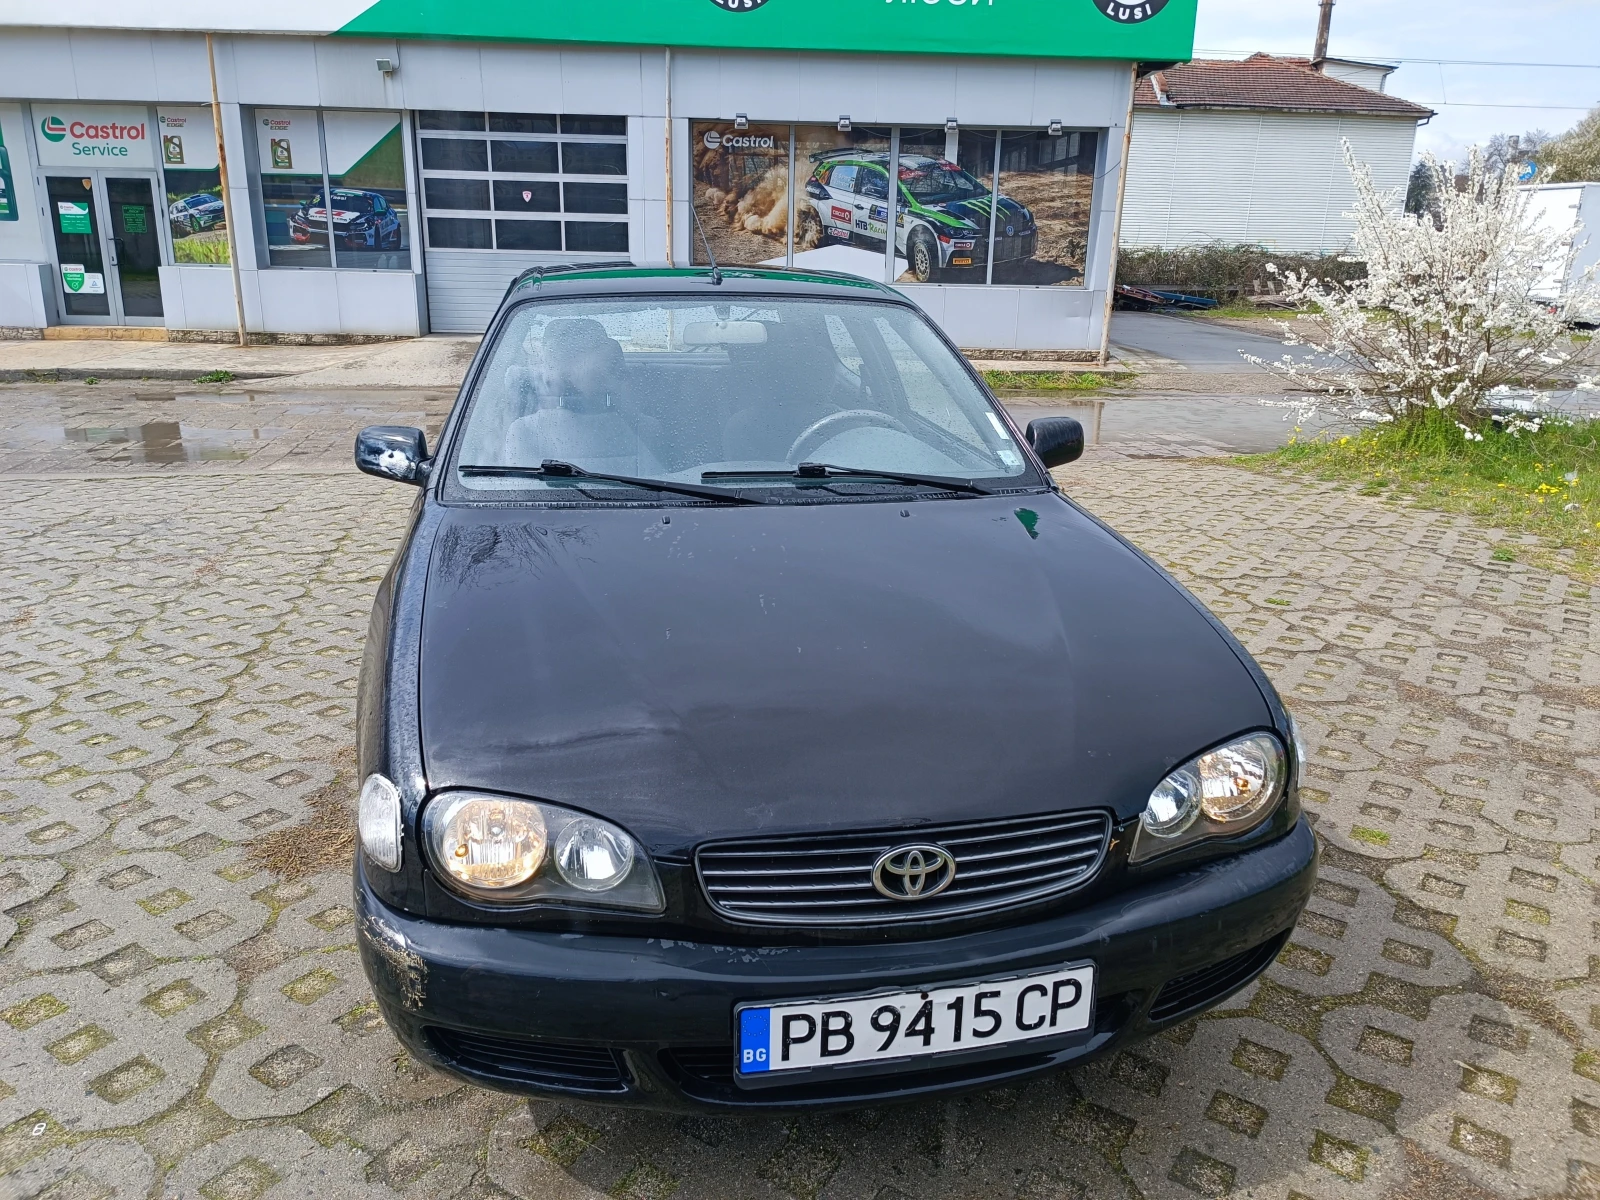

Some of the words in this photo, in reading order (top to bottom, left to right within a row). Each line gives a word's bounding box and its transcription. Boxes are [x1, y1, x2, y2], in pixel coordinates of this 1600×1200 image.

[1106, 2, 1152, 20] LUSI
[69, 121, 145, 140] Castrol
[72, 142, 128, 157] Service
[722, 134, 774, 148] Castrol
[855, 219, 868, 231] HTB
[780, 1010, 855, 1062] PB
[870, 990, 1001, 1052] 9415
[1015, 977, 1082, 1031] CP
[743, 1047, 767, 1064] BG
